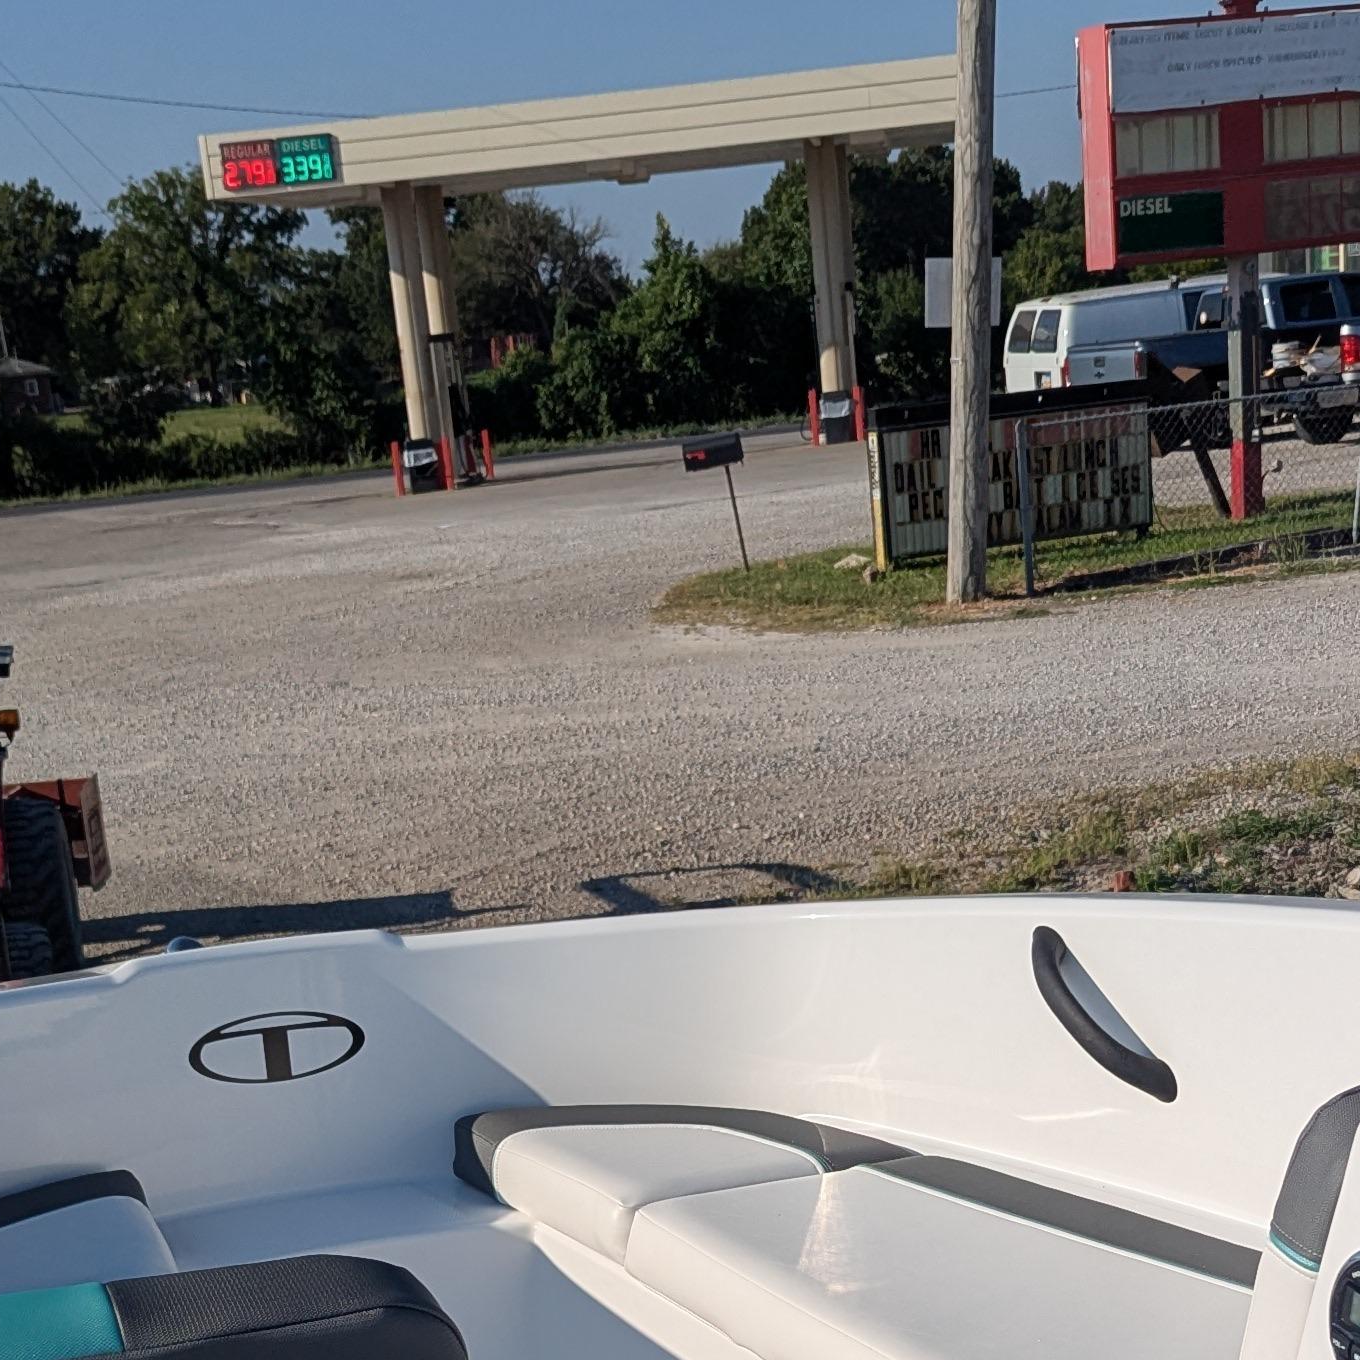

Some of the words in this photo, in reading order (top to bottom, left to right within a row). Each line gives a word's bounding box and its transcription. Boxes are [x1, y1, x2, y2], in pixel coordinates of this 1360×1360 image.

[223, 143, 271, 160] REGULAR
[282, 138, 326, 154] DIESEL
[1120, 196, 1172, 217] DIESEL
